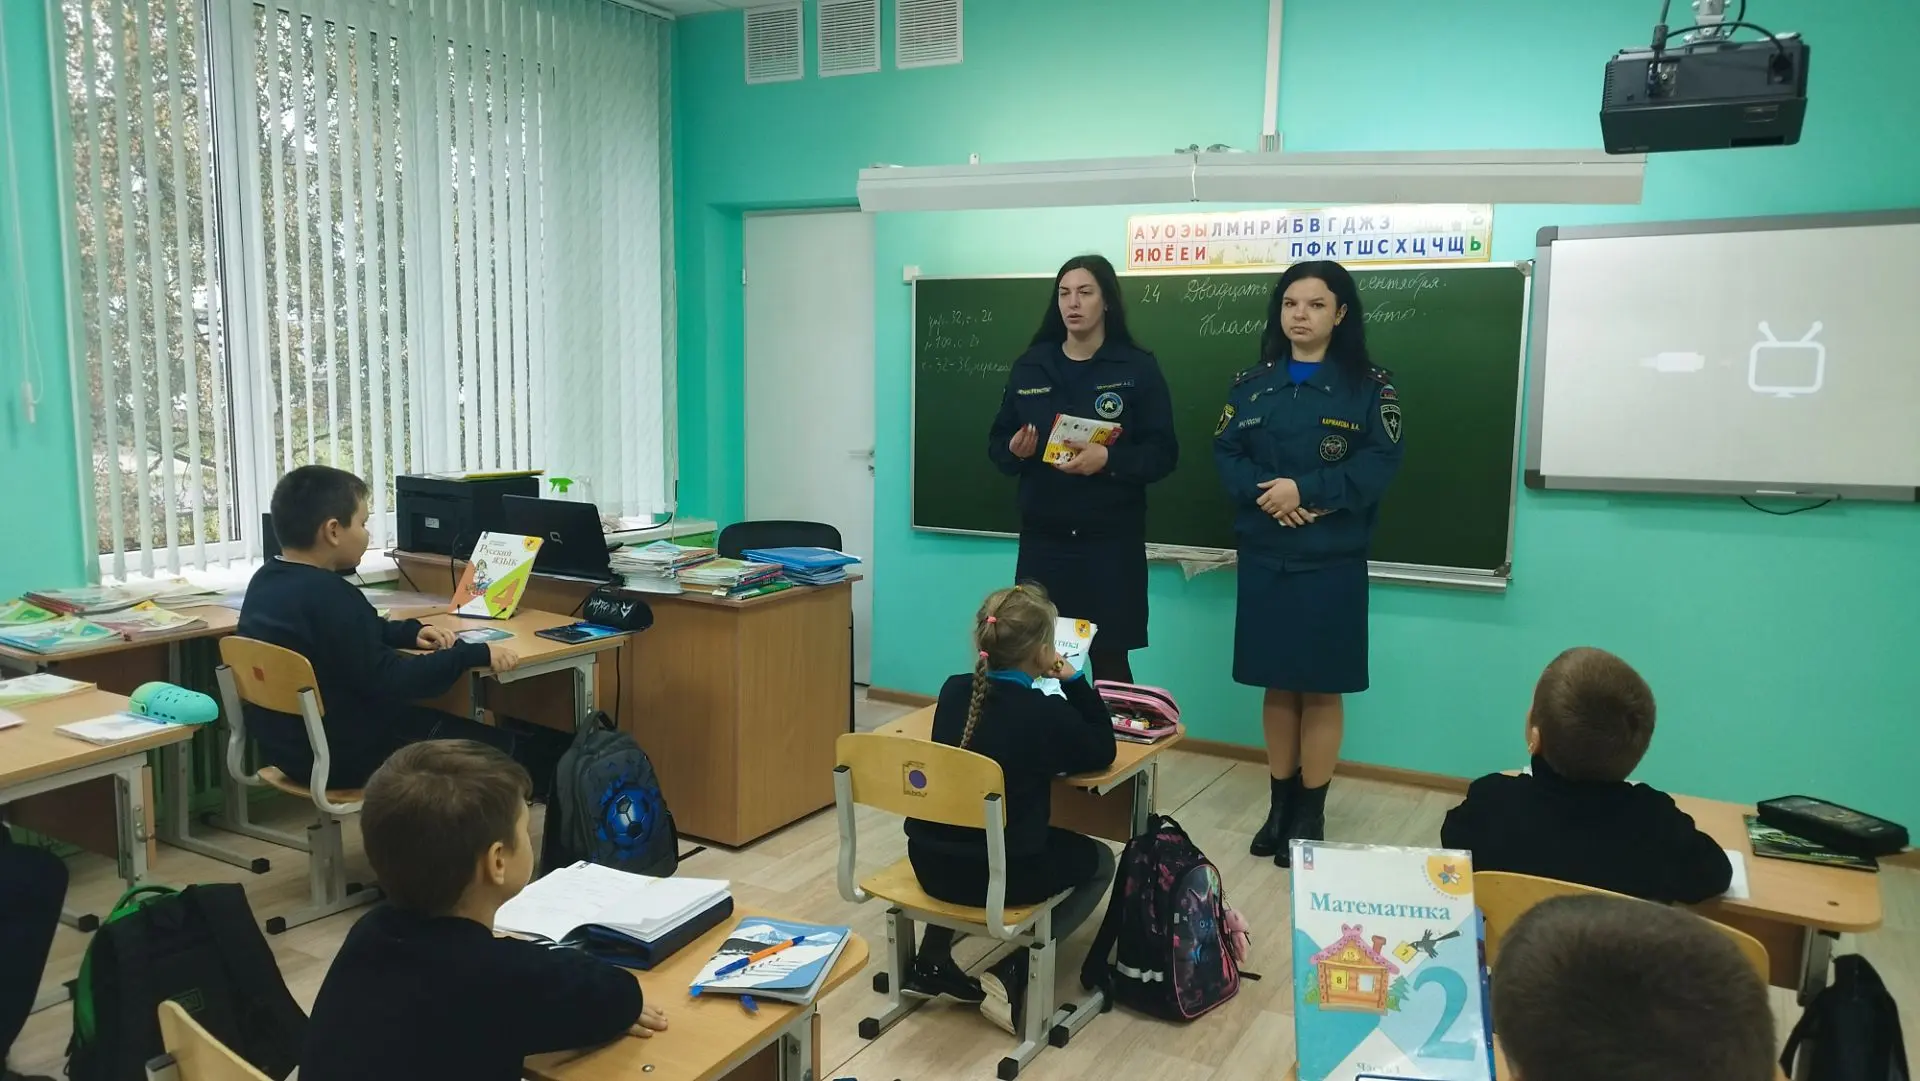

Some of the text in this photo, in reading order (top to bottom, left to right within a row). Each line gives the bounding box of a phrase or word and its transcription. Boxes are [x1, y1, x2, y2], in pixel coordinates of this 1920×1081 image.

[1141, 283, 1160, 303] 24
[1184, 277, 1268, 310] Двадцать
[479, 543, 513, 557] Русский
[491, 577, 521, 609] 4
[1310, 891, 1451, 921] Математика
[1413, 965, 1477, 1061] 2
